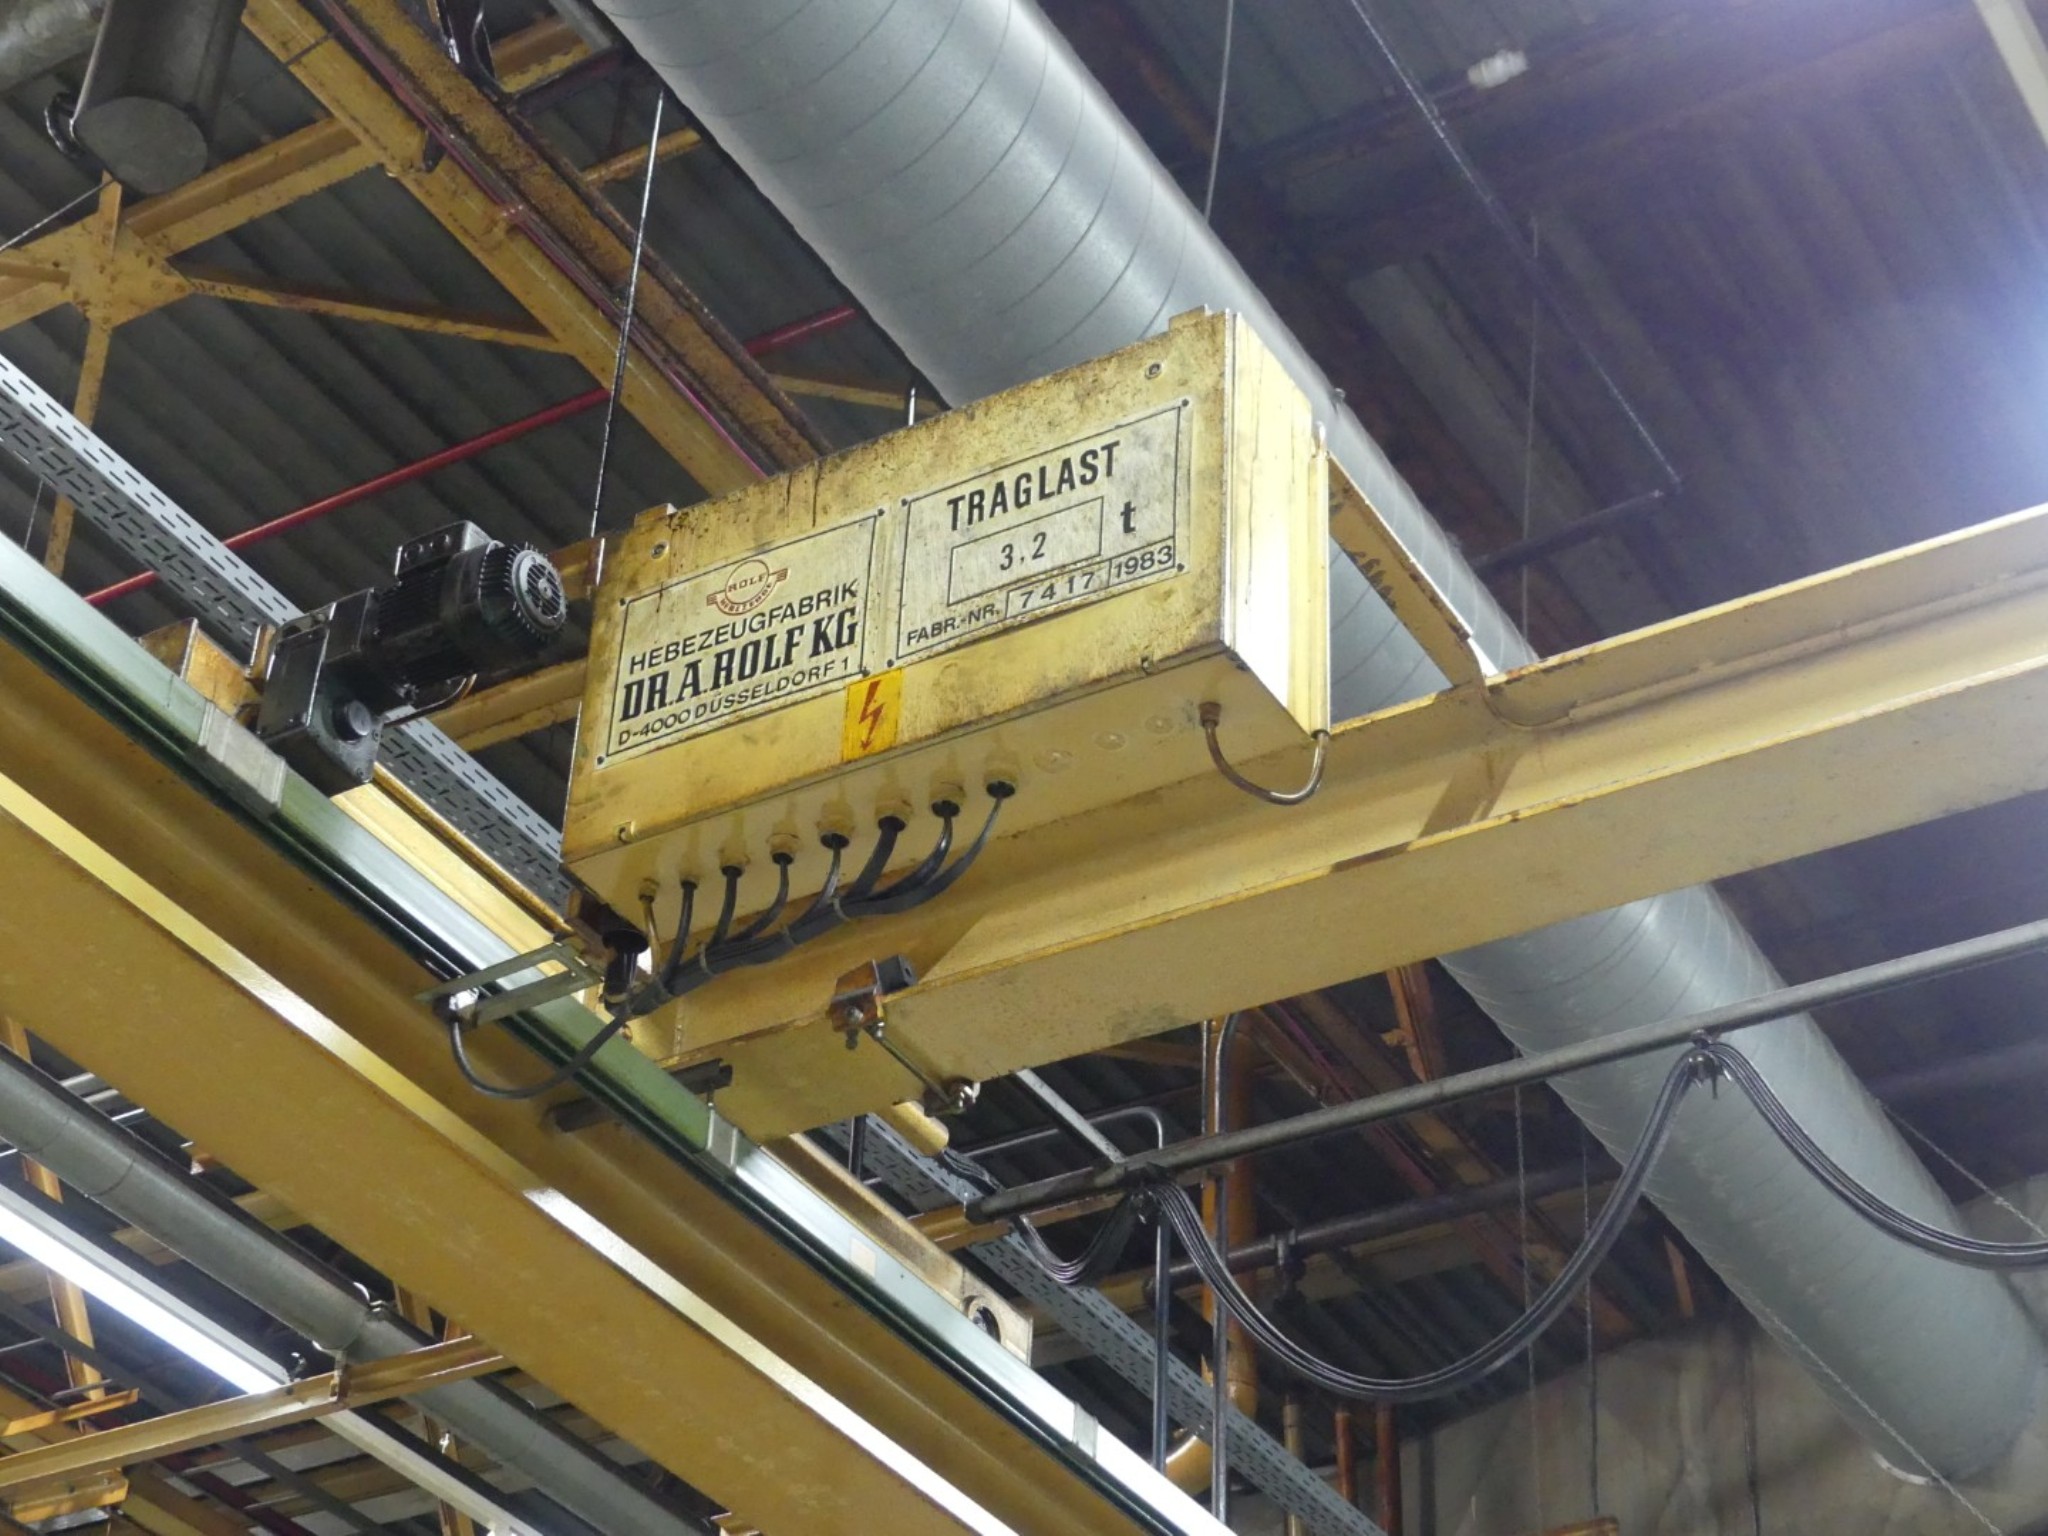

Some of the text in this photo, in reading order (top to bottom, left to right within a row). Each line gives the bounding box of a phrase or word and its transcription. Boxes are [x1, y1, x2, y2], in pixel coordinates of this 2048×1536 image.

[946, 440, 1121, 531] TRAGLAST
[1120, 501, 1136, 533] t
[629, 579, 858, 674] HEBEZEUGFABRIK
[809, 607, 858, 658] KG
[906, 545, 1173, 645] FABR.-NR. 7417 1983
[618, 656, 849, 745] D-4000 DÜSSELDORF 1
